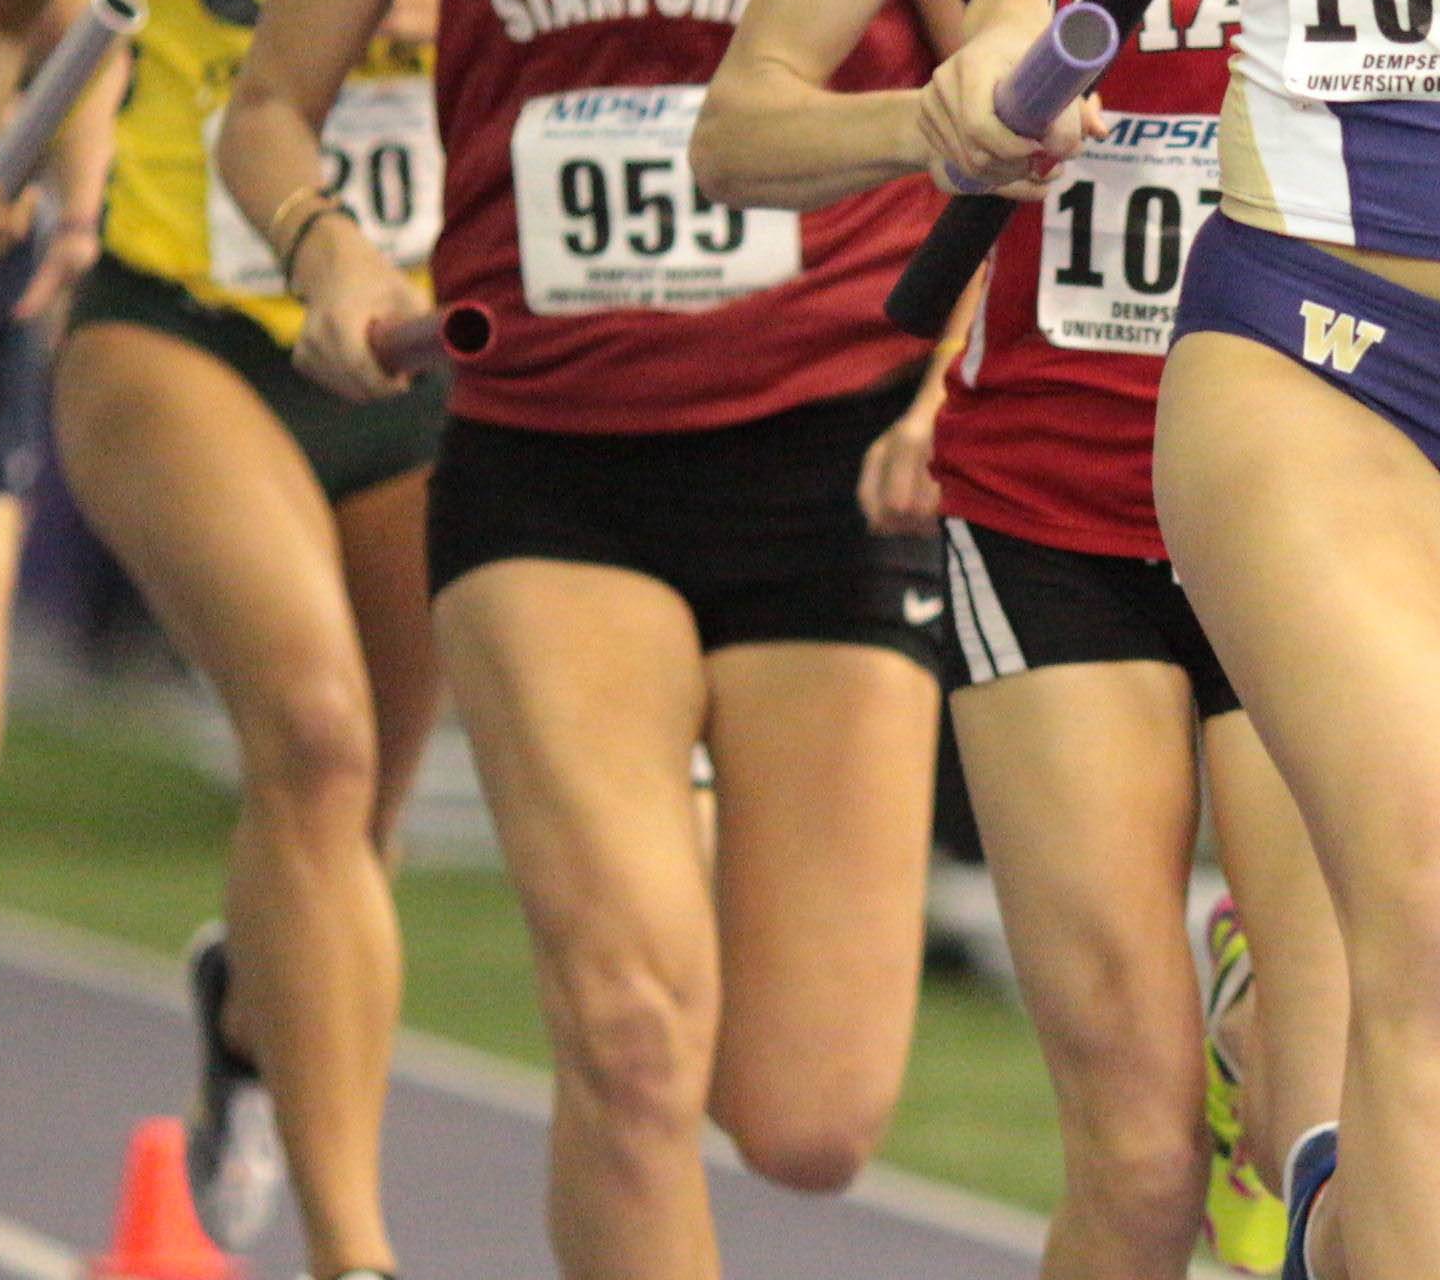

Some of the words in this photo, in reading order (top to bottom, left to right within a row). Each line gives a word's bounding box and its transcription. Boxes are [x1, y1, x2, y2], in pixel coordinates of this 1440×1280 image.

[1307, 74, 1418, 94] UNIVERSITY
[560, 157, 746, 258] 955
[1056, 180, 1222, 297] 10
[1299, 300, 1387, 375] W
